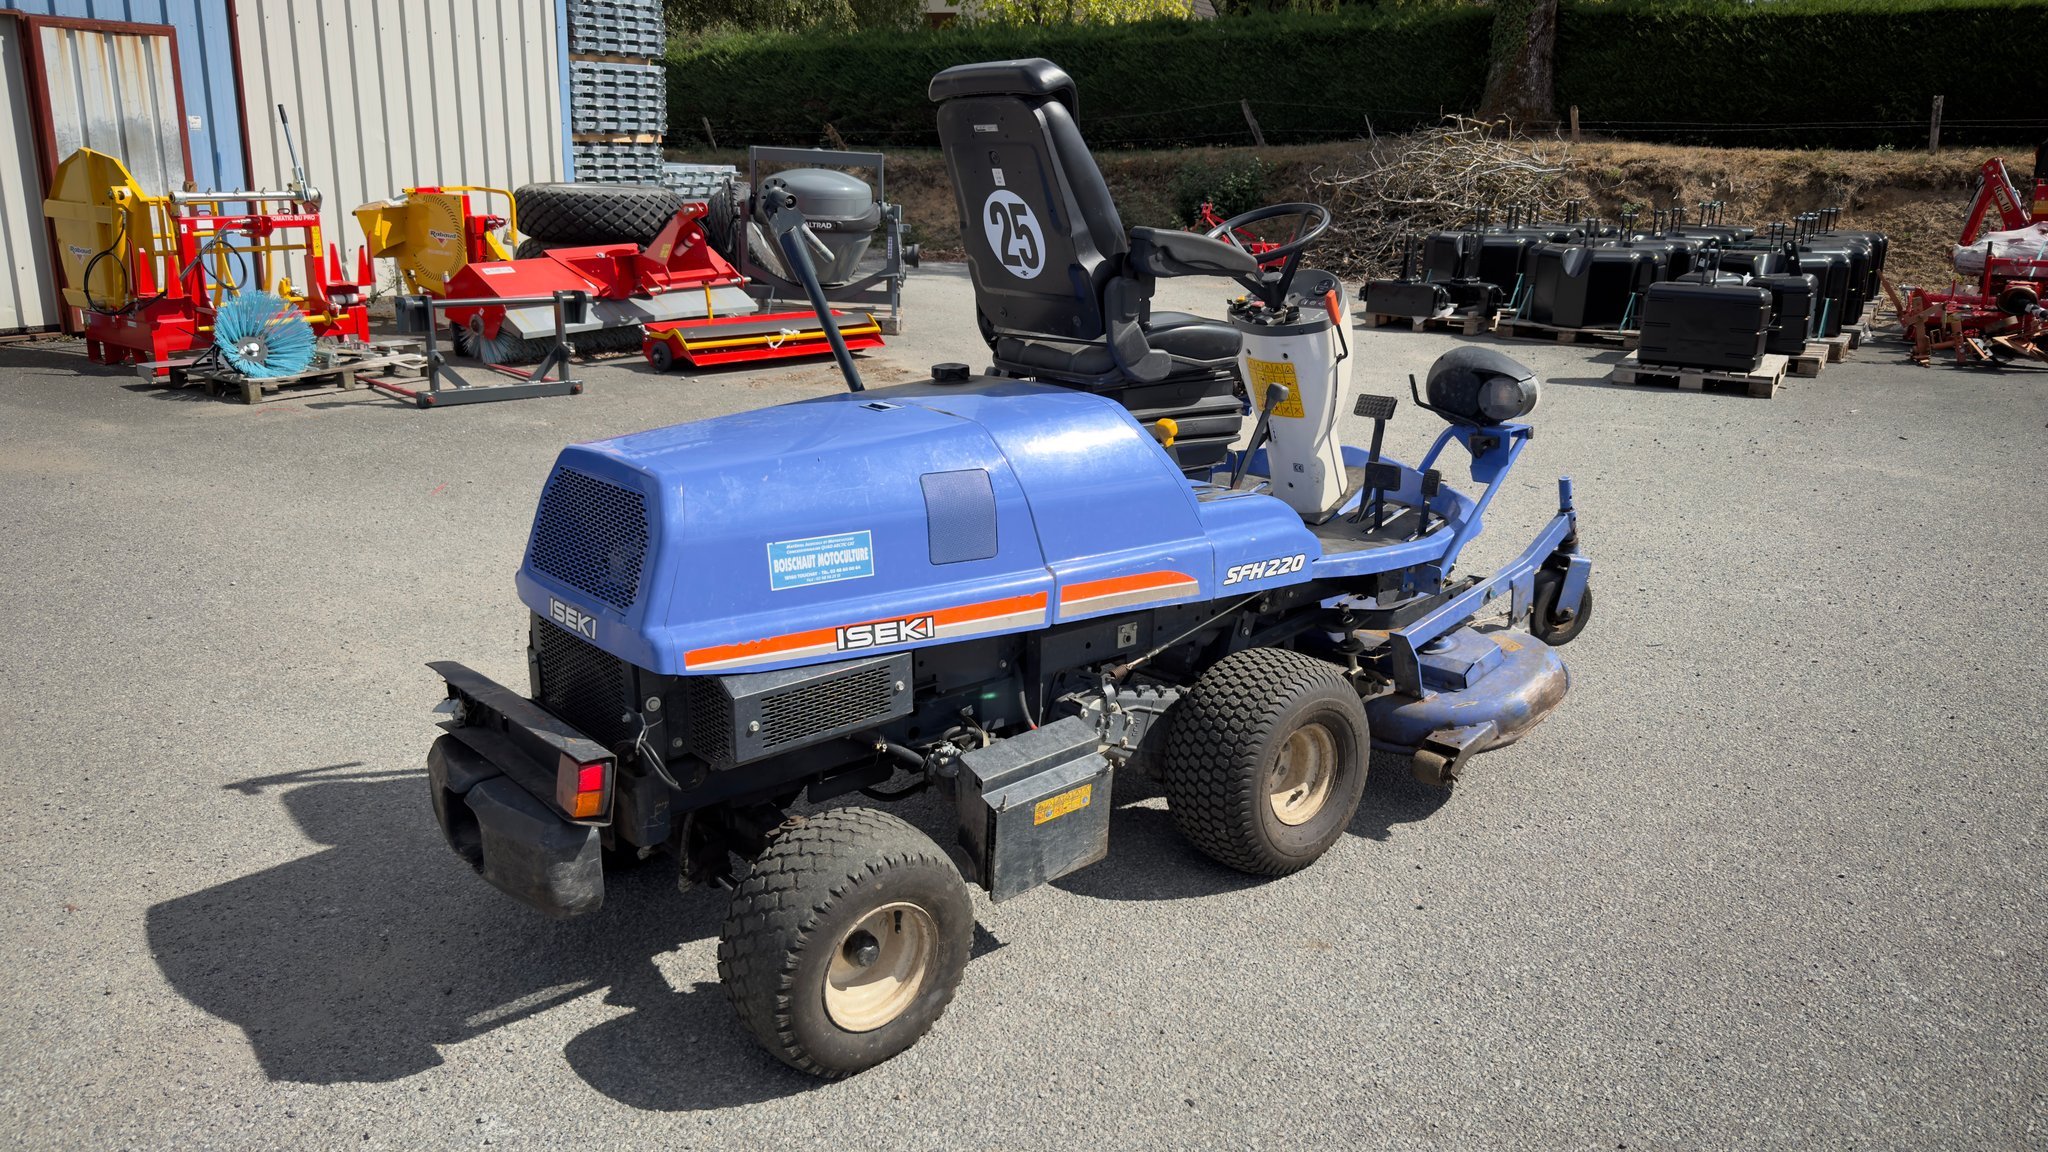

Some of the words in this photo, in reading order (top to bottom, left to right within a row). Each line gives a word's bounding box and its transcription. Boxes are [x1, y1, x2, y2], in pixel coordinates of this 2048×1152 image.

[430, 230, 457, 239] Rabaud
[989, 201, 1040, 270] 25
[773, 554, 817, 574] BOISCHAUT
[817, 547, 869, 567] MOTOCULTURE
[1223, 553, 1306, 586] SFH220
[548, 597, 597, 640] ISEKI
[835, 616, 936, 652] ISEKI
